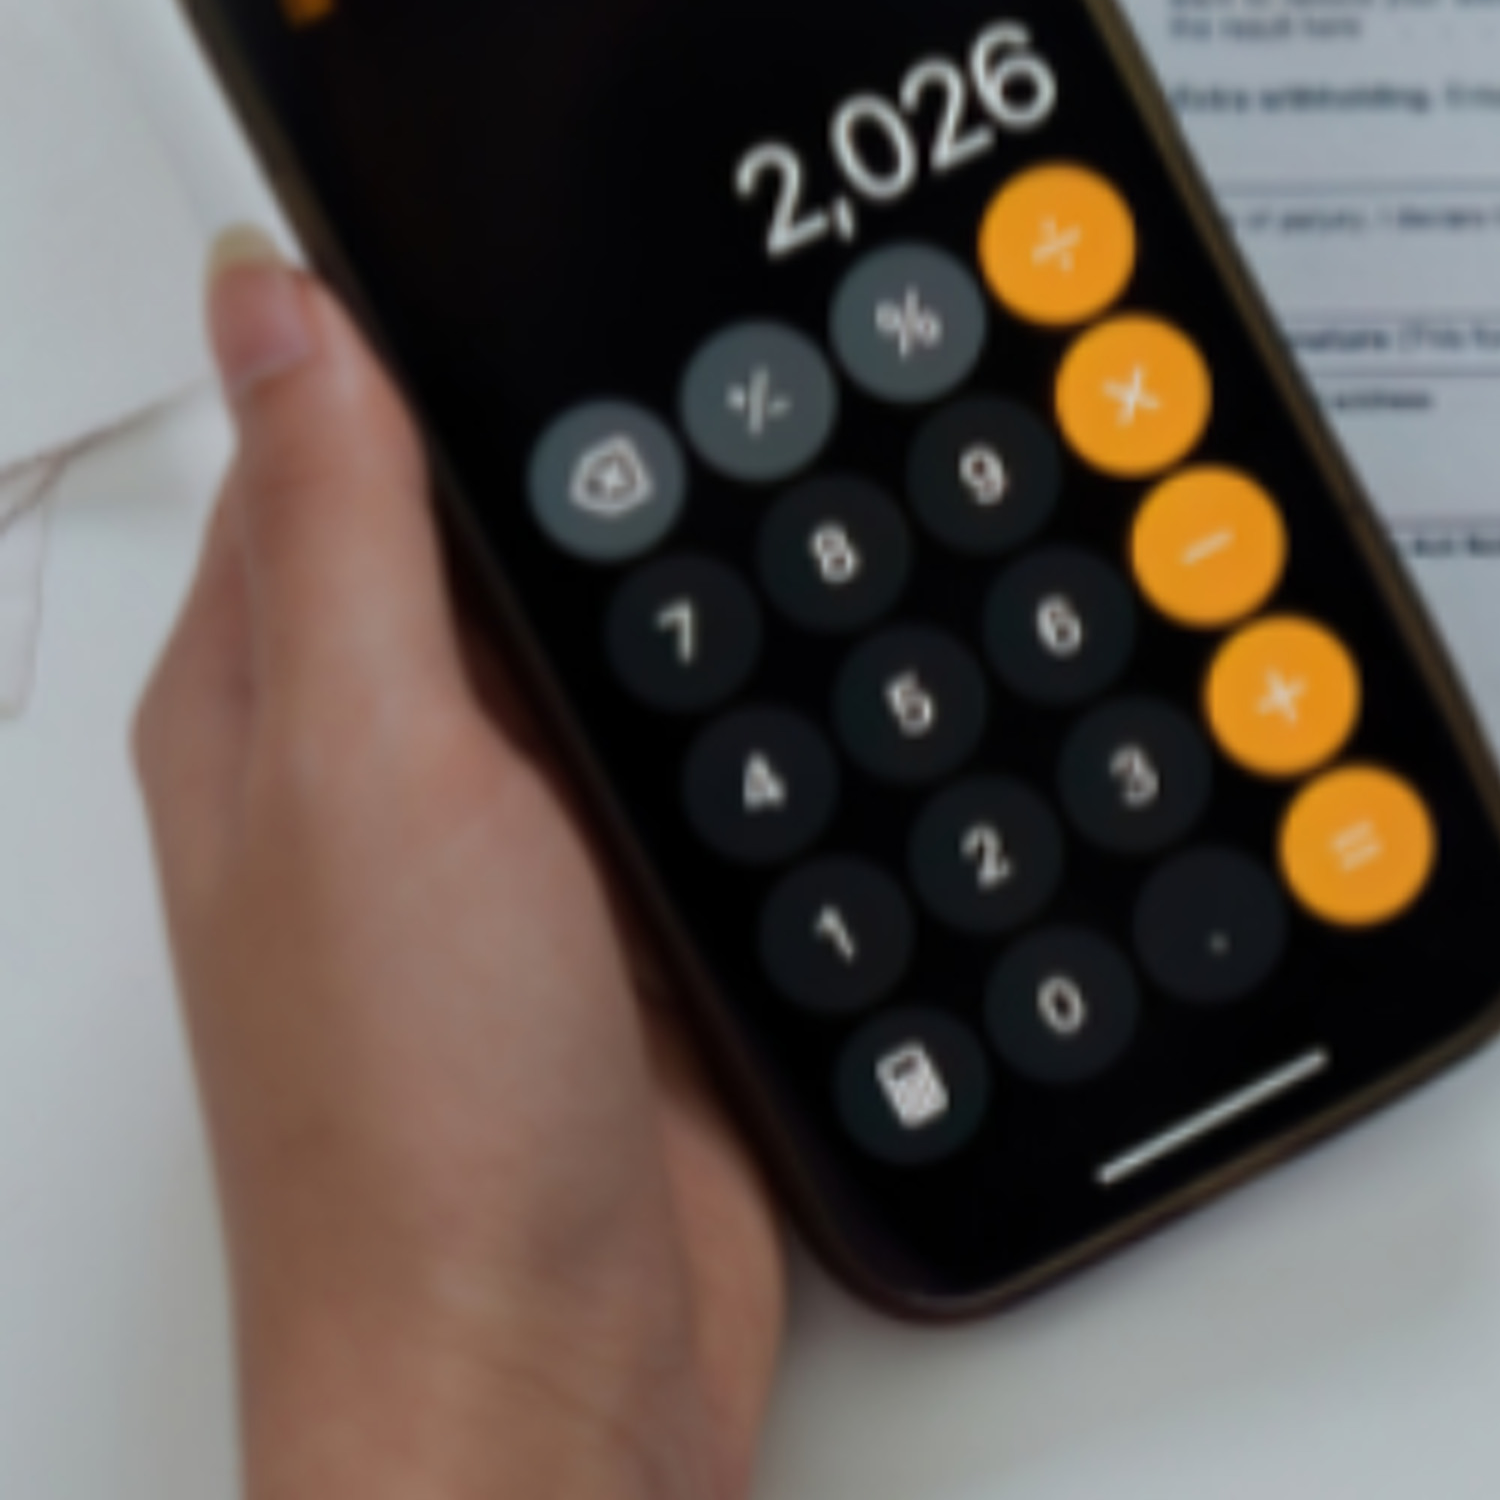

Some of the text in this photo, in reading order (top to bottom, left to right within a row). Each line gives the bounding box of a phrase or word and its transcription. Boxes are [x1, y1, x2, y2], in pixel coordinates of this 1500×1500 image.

[735, 19, 1057, 258] 2,026
[959, 444, 1008, 505] 9
[809, 522, 861, 584] 8
[655, 598, 694, 664] 7
[1036, 594, 1083, 656] 6
[741, 750, 786, 811] 4
[1109, 743, 1159, 809] 3
[959, 823, 1010, 889] 2
[816, 905, 855, 964] 1
[1036, 975, 1084, 1034] 0
